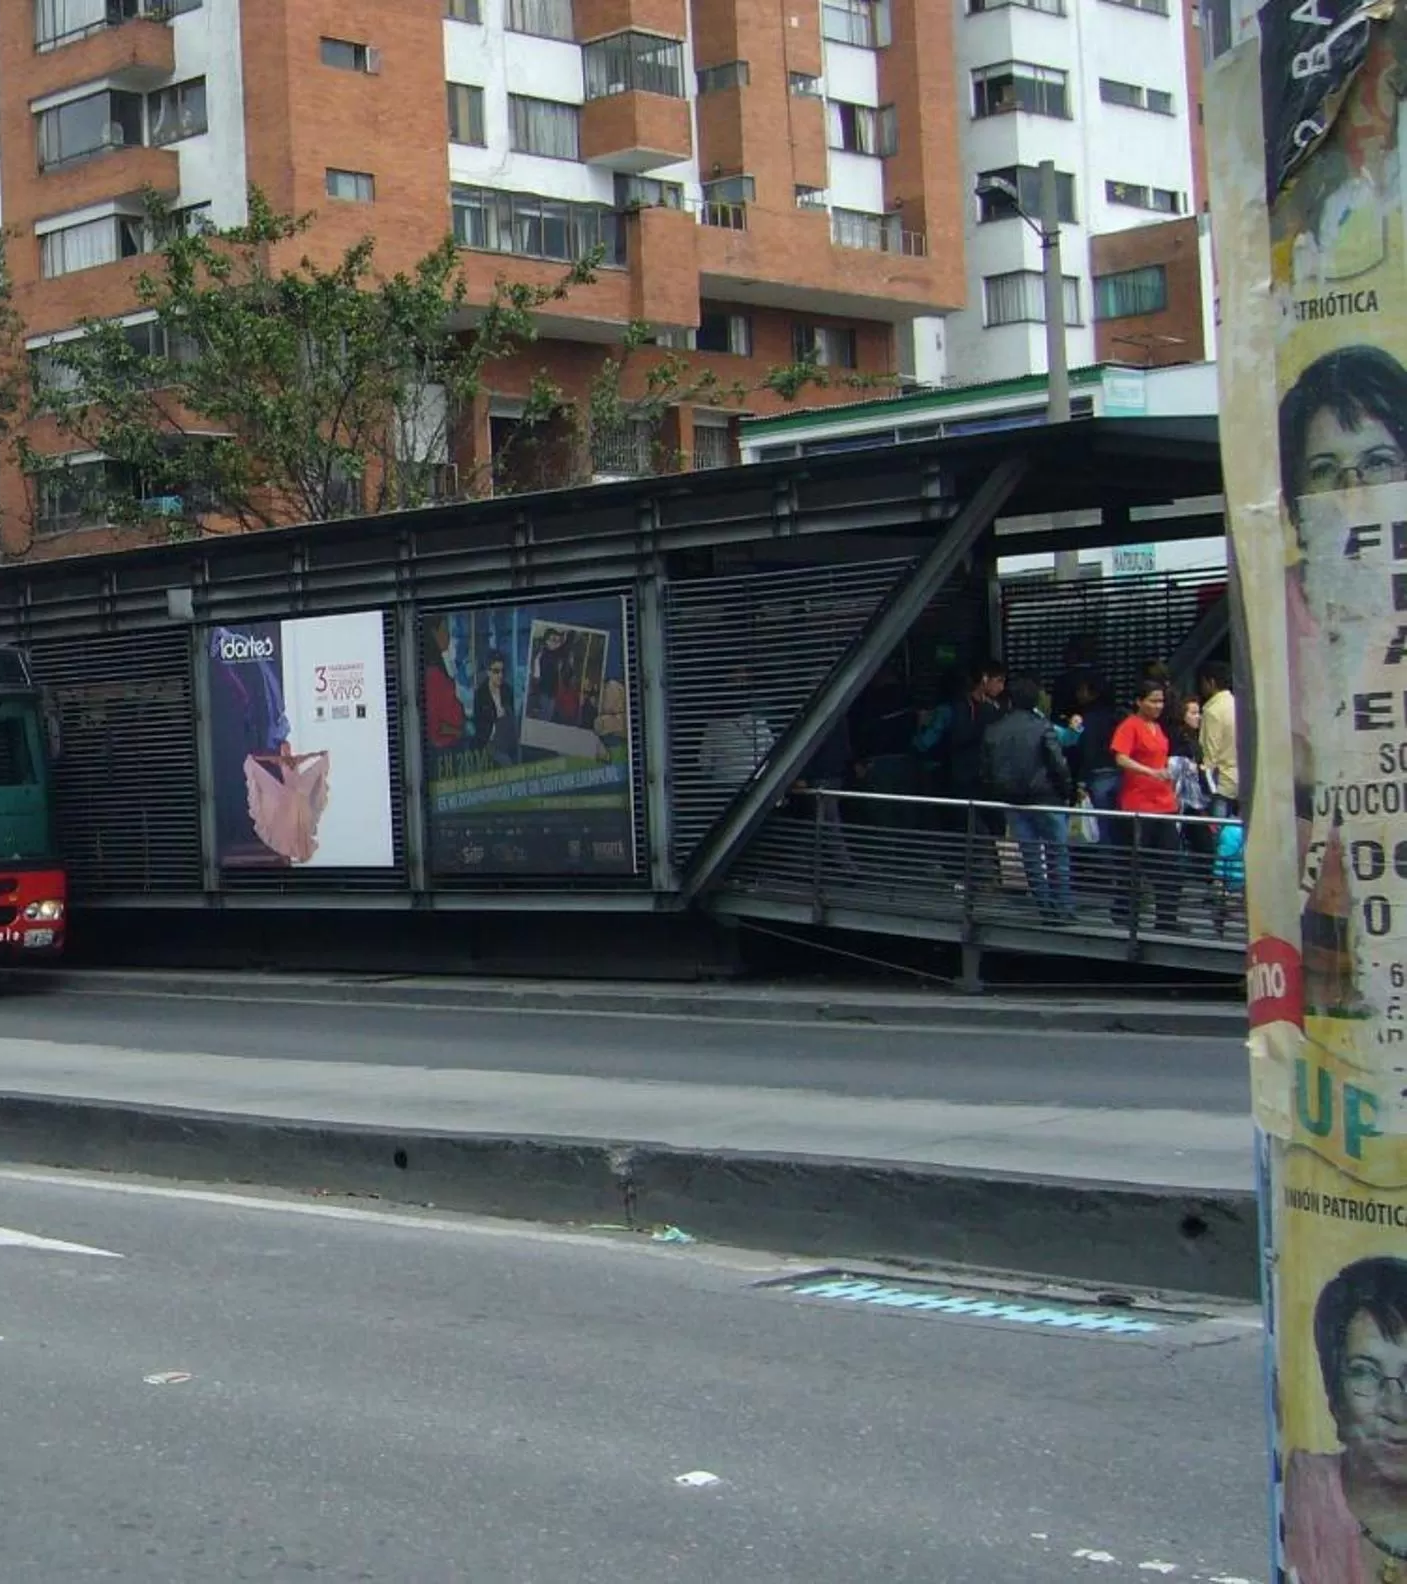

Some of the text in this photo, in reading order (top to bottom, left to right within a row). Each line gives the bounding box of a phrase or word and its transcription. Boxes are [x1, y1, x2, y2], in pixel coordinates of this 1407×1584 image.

[1291, 290, 1379, 321] TRIÓTICA
[1294, 1057, 1388, 1161] UP
[1323, 1195, 1407, 1228] PATRIÓTIC
